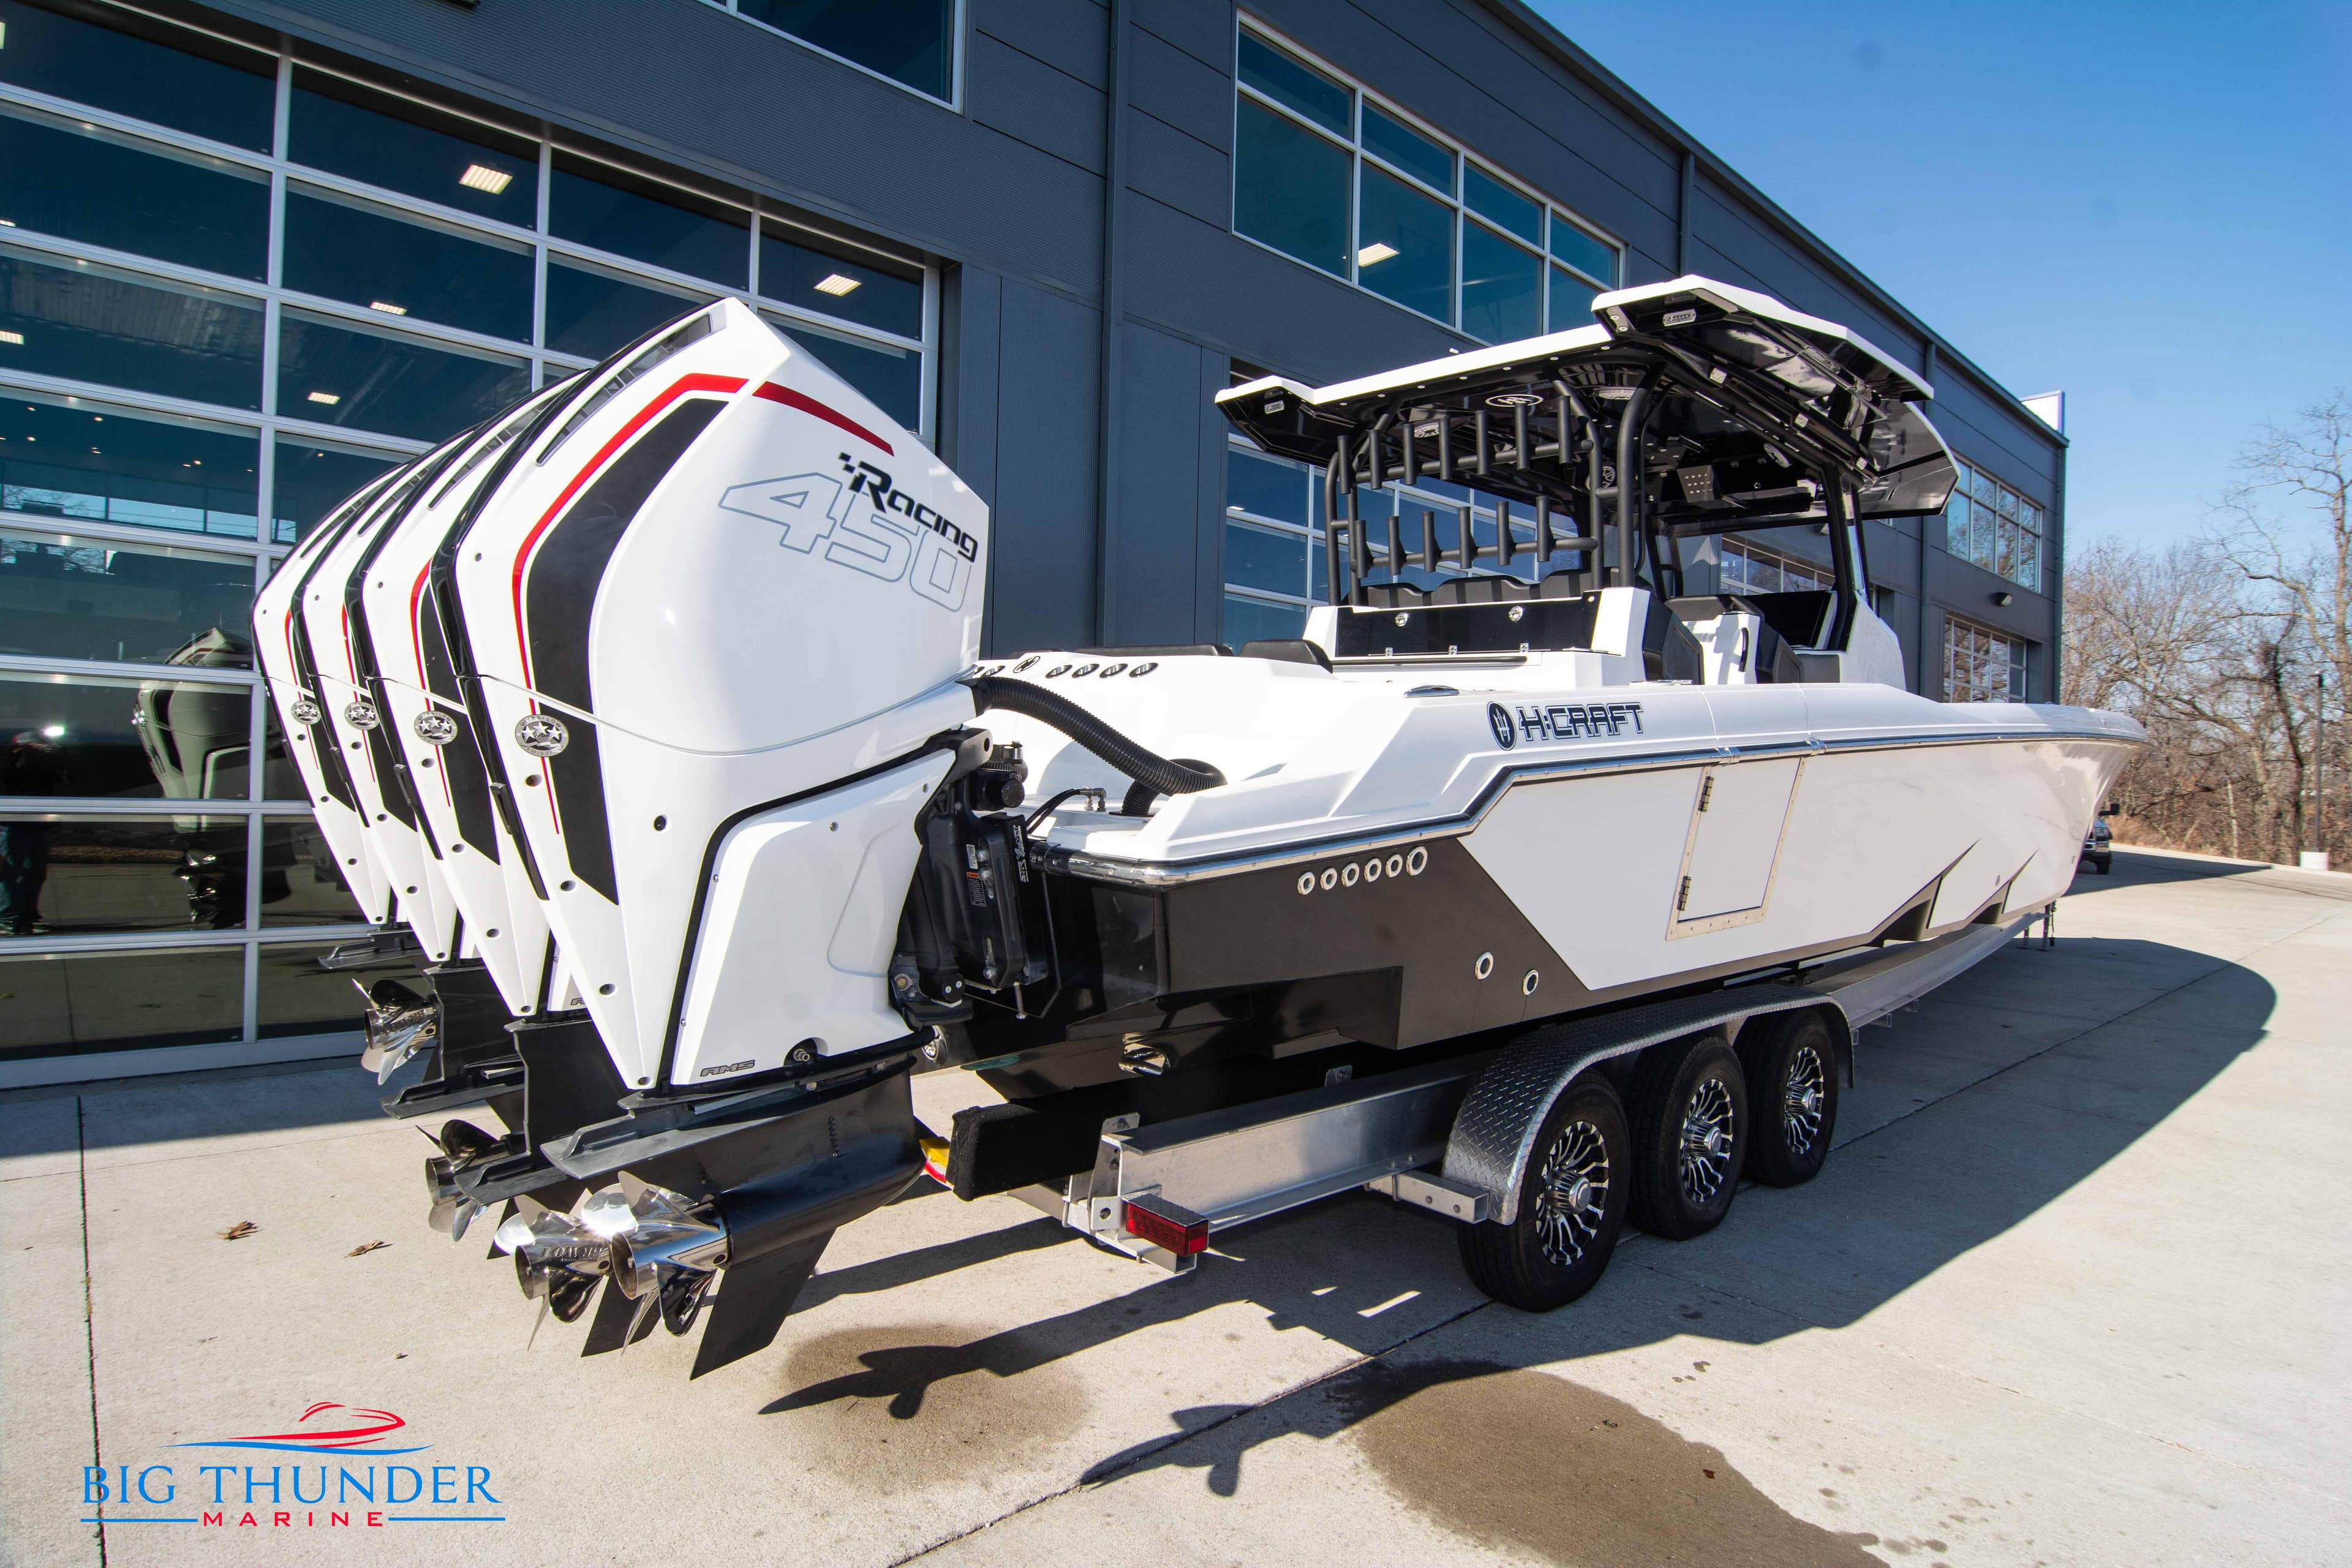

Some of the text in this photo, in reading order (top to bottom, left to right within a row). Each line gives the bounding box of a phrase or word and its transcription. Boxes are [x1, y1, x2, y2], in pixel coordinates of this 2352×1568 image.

[718, 472, 971, 612] 450
[839, 452, 979, 564] Racing
[546, 717, 562, 728] LOW
